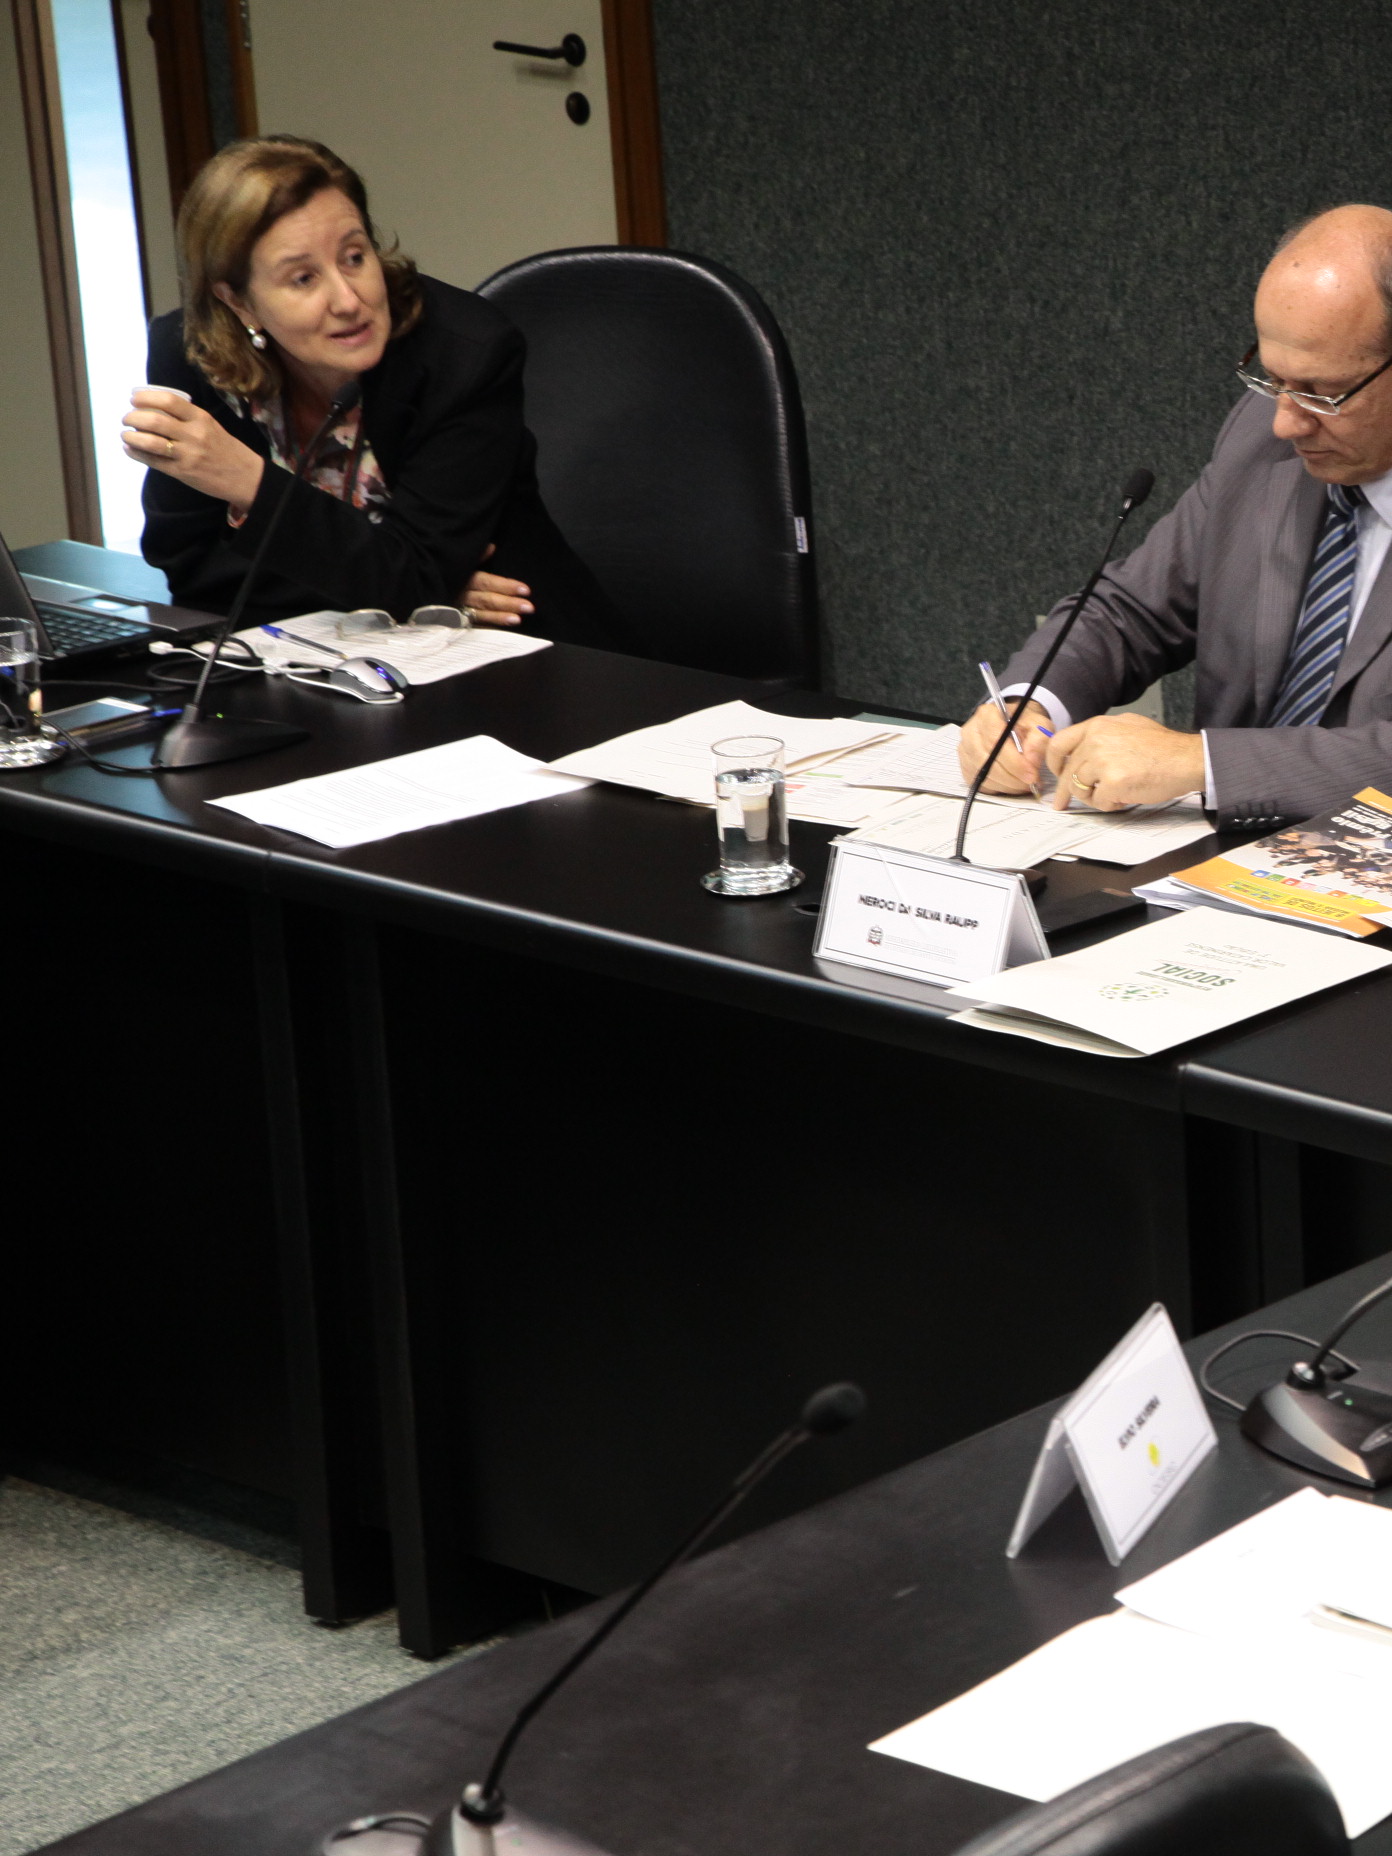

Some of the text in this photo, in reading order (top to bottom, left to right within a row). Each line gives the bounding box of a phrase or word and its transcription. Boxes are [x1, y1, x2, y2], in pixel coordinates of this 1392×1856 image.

[859, 895, 896, 911] NEROCI
[915, 908, 941, 922] SILVA
[1152, 963, 1235, 987] SOCIAL
